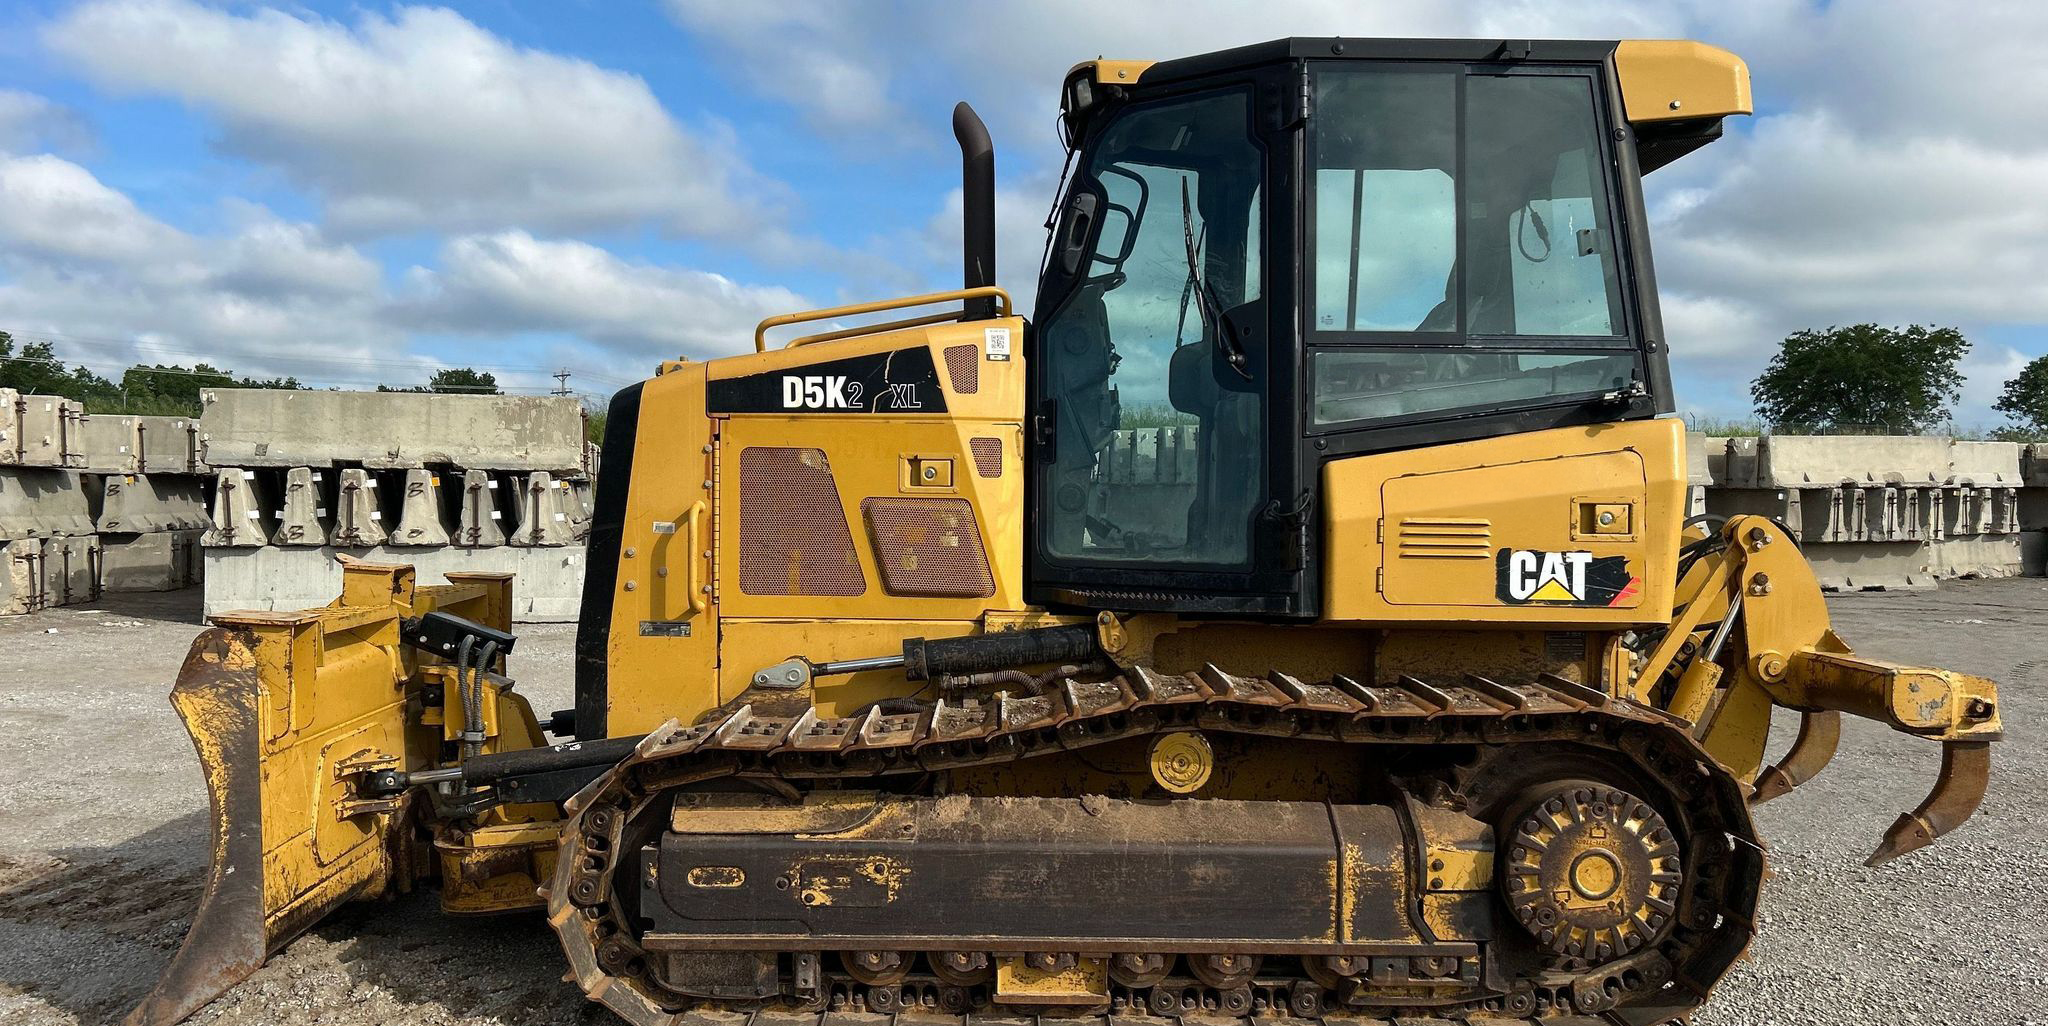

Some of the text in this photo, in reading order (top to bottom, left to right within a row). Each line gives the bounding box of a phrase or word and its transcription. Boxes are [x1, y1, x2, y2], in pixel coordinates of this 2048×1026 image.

[783, 375, 922, 408] D5K2 XL
[1509, 551, 1592, 600] CAT
